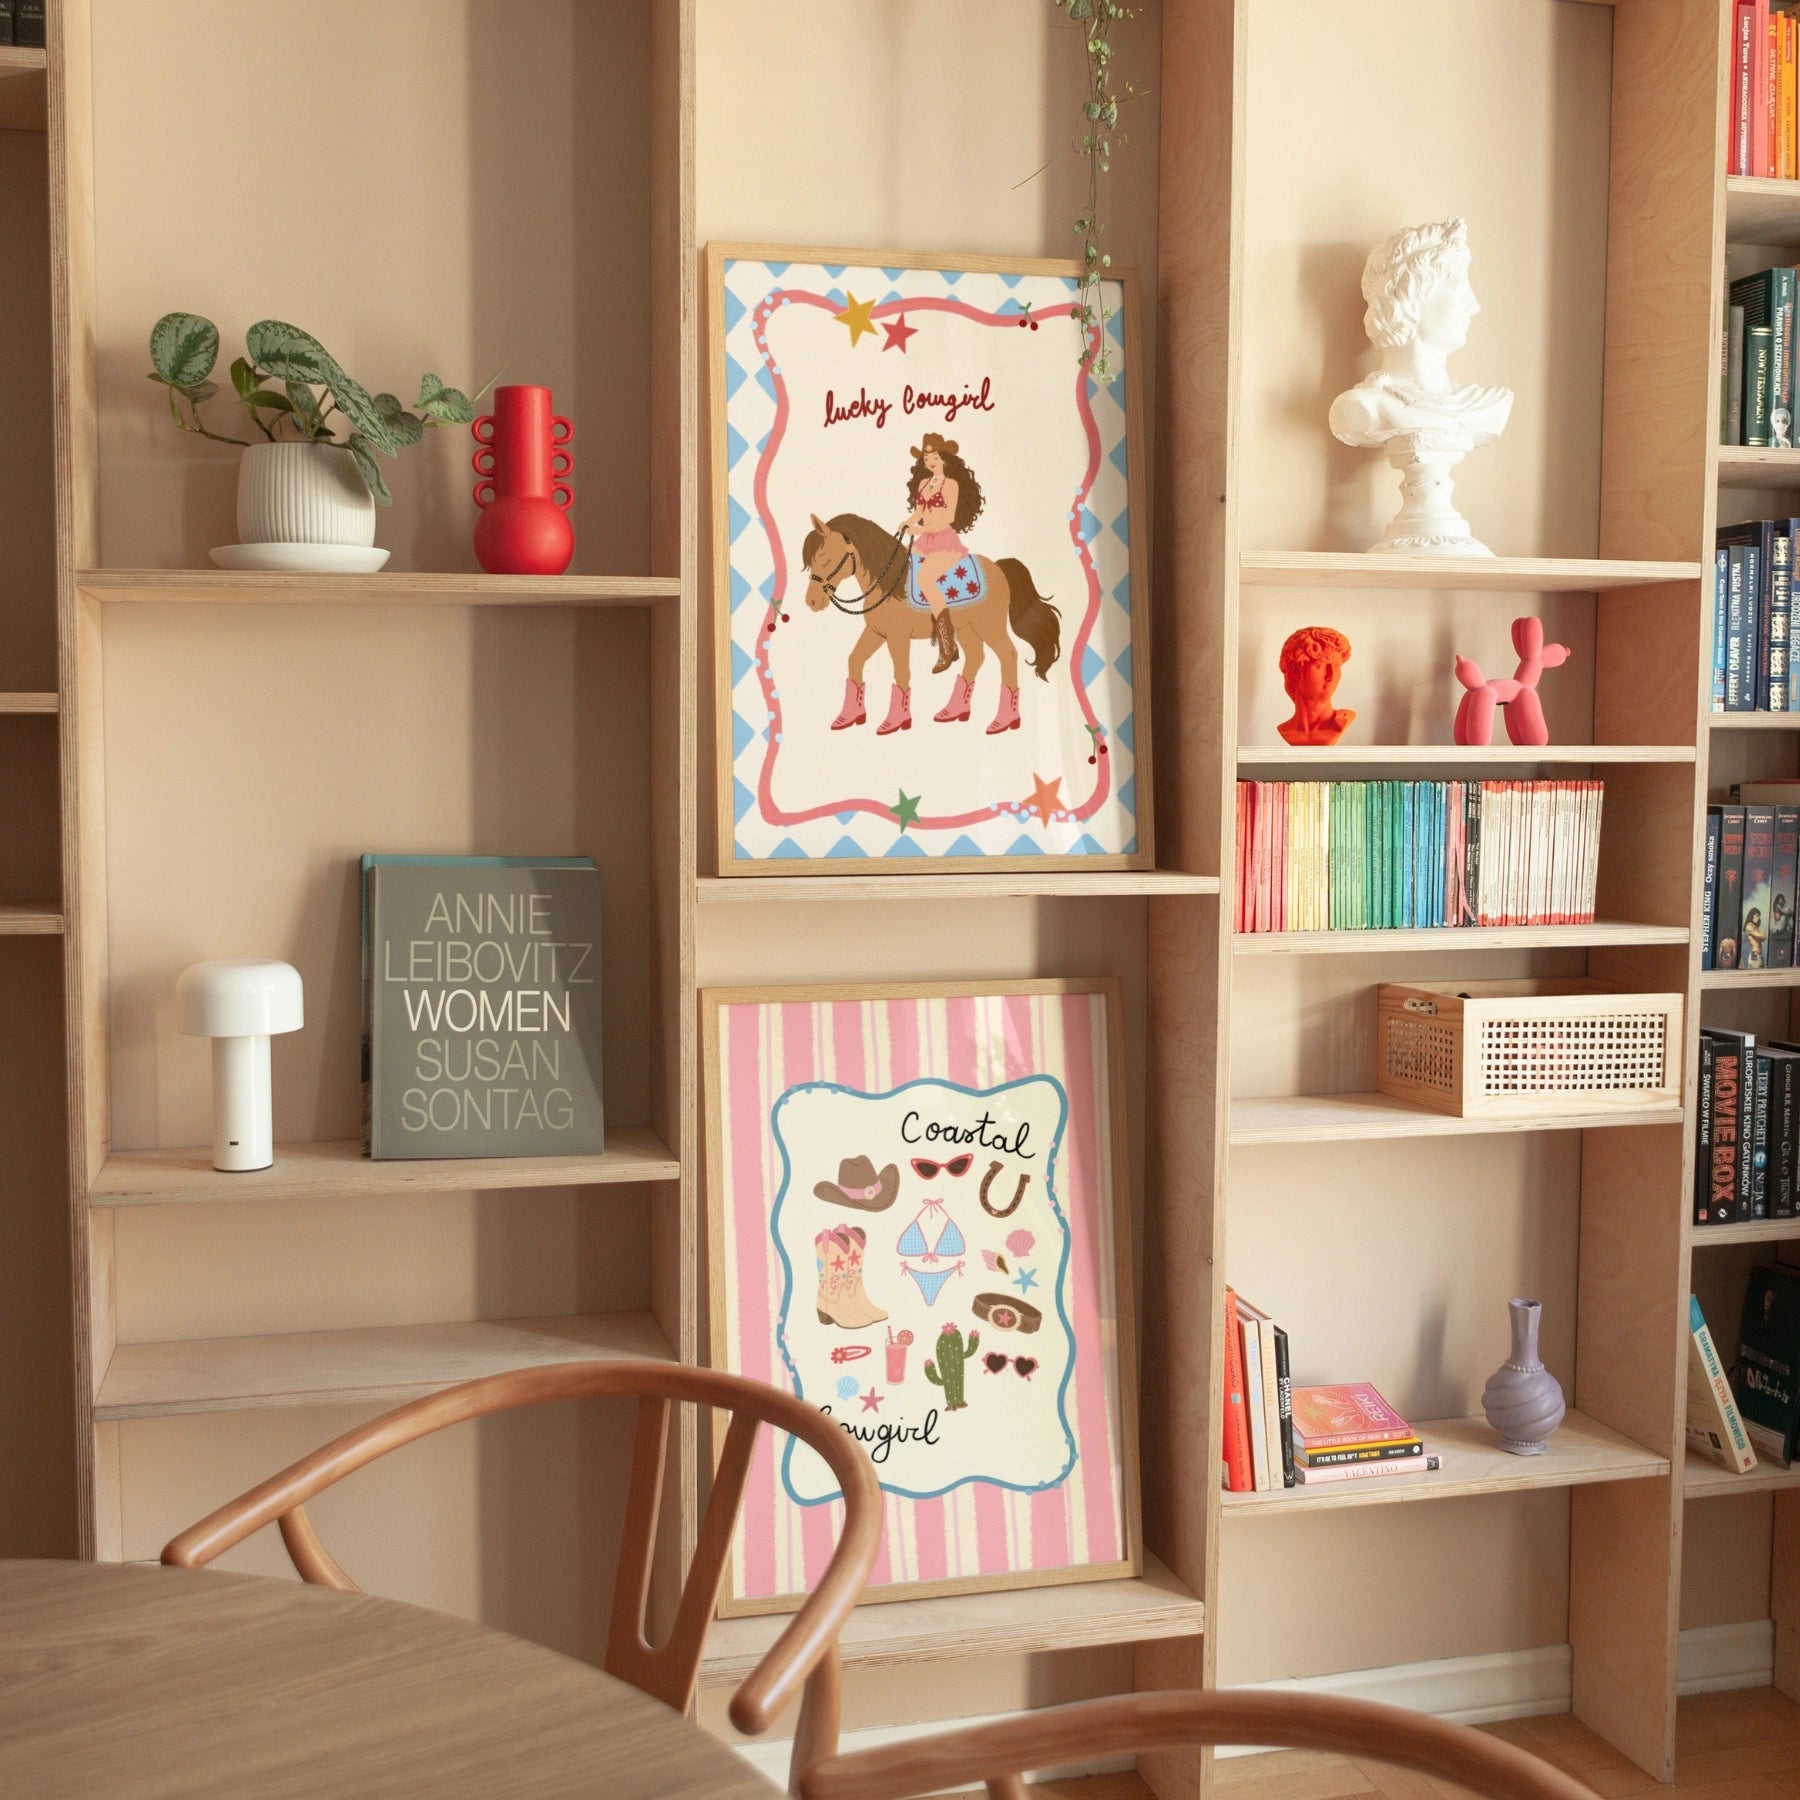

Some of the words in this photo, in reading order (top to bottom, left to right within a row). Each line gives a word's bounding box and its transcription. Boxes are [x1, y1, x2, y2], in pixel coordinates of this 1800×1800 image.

[1742, 16, 1750, 41] Lucjan
[1742, 42, 1750, 65] Turos
[1740, 71, 1749, 121] ANDRAGOGIKA
[1775, 307, 1783, 337] PRAWDA
[1757, 349, 1767, 374] NOWY
[1774, 344, 1783, 396] SZCZEPIONKACH
[824, 387, 892, 428] lucky
[903, 376, 995, 424] Cowgirl
[1756, 376, 1766, 424] TESTAMENT
[1731, 563, 1741, 592] PUSTKA
[1790, 591, 1800, 627] URODZENI
[1730, 637, 1740, 670] DEAVER
[1790, 629, 1800, 663] BIEGACZE
[1729, 673, 1738, 705] JEFFERY
[1707, 835, 1715, 861] smoka
[1705, 860, 1715, 883] Oczy
[424, 892, 553, 935] ANNIE
[1704, 891, 1712, 913] KING
[1703, 914, 1711, 953] STEPHEN
[384, 940, 594, 984] LEIBOVITZ
[403, 988, 571, 1033] WOMEN
[415, 1038, 560, 1082] SUSAN
[1702, 1073, 1711, 1109] ŚWIATŁO
[1743, 1050, 1753, 1111] EUROPEJSKIE
[1757, 1071, 1768, 1096] TERRY
[401, 1087, 574, 1132] SONTAG
[1702, 1109, 1710, 1118] W
[1713, 1055, 1738, 1144] MOVIE
[900, 1111, 1036, 1159] Coastal
[1701, 1119, 1709, 1145] FILMIE
[1743, 1114, 1752, 1139] KINO
[1756, 1098, 1767, 1147] PRATCHETT
[1711, 1146, 1736, 1202] BOX
[1741, 1142, 1751, 1196] GATUNKÓW
[1278, 1377, 1284, 1386] BY
[1283, 1377, 1292, 1419] CHANEL
[1699, 1331, 1719, 1378] GRAMATYKA
[1714, 1377, 1729, 1405] JĘZYKA
[1724, 1404, 1745, 1450] FILMOWEGO
[1344, 1464, 1398, 1478] VALENTINO
